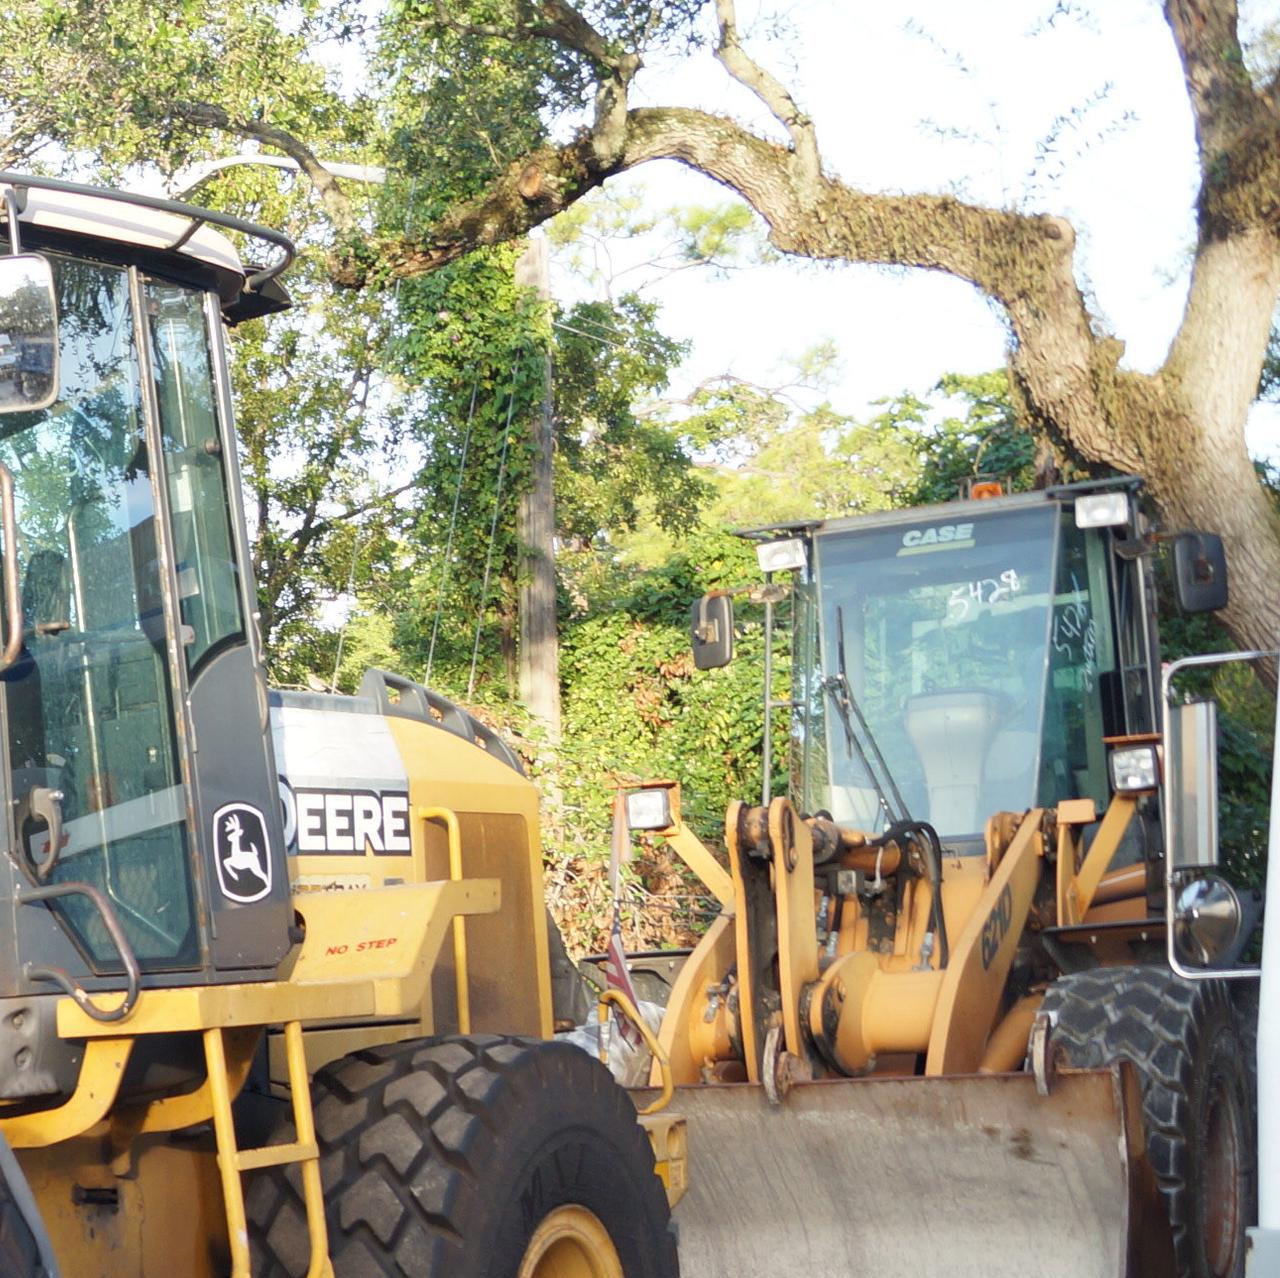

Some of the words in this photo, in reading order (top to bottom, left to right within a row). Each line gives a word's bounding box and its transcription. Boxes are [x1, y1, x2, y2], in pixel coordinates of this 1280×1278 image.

[902, 523, 974, 548] CASE
[325, 944, 349, 957] NO
[355, 937, 398, 953] STEP
